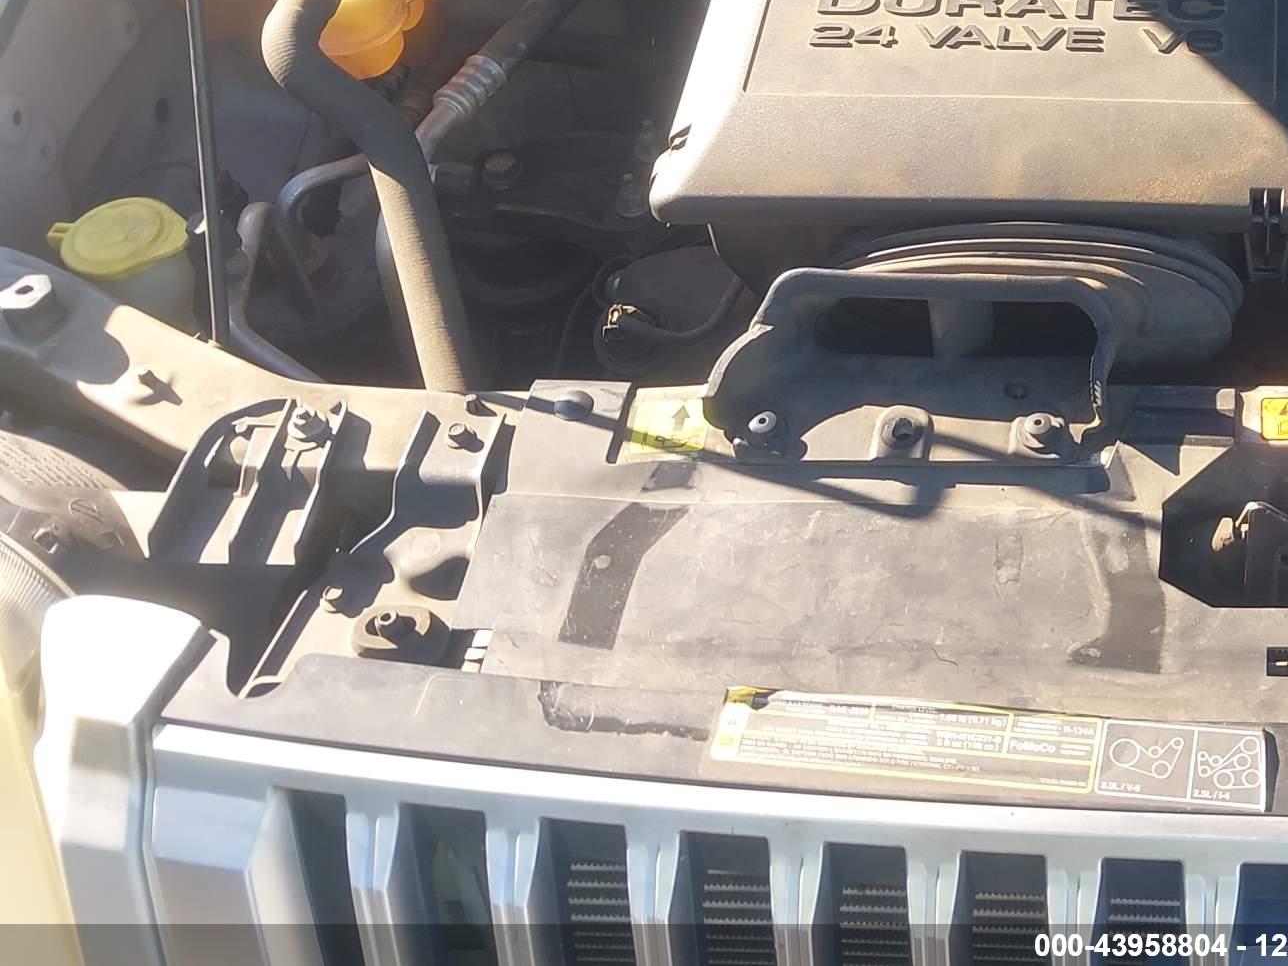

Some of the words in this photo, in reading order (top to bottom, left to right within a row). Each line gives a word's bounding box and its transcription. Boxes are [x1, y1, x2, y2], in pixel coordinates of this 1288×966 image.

[809, 22, 899, 48] 24
[919, 24, 1105, 53] VALVE
[1142, 28, 1225, 55] V6
[1009, 739, 1057, 754] FoMoCo
